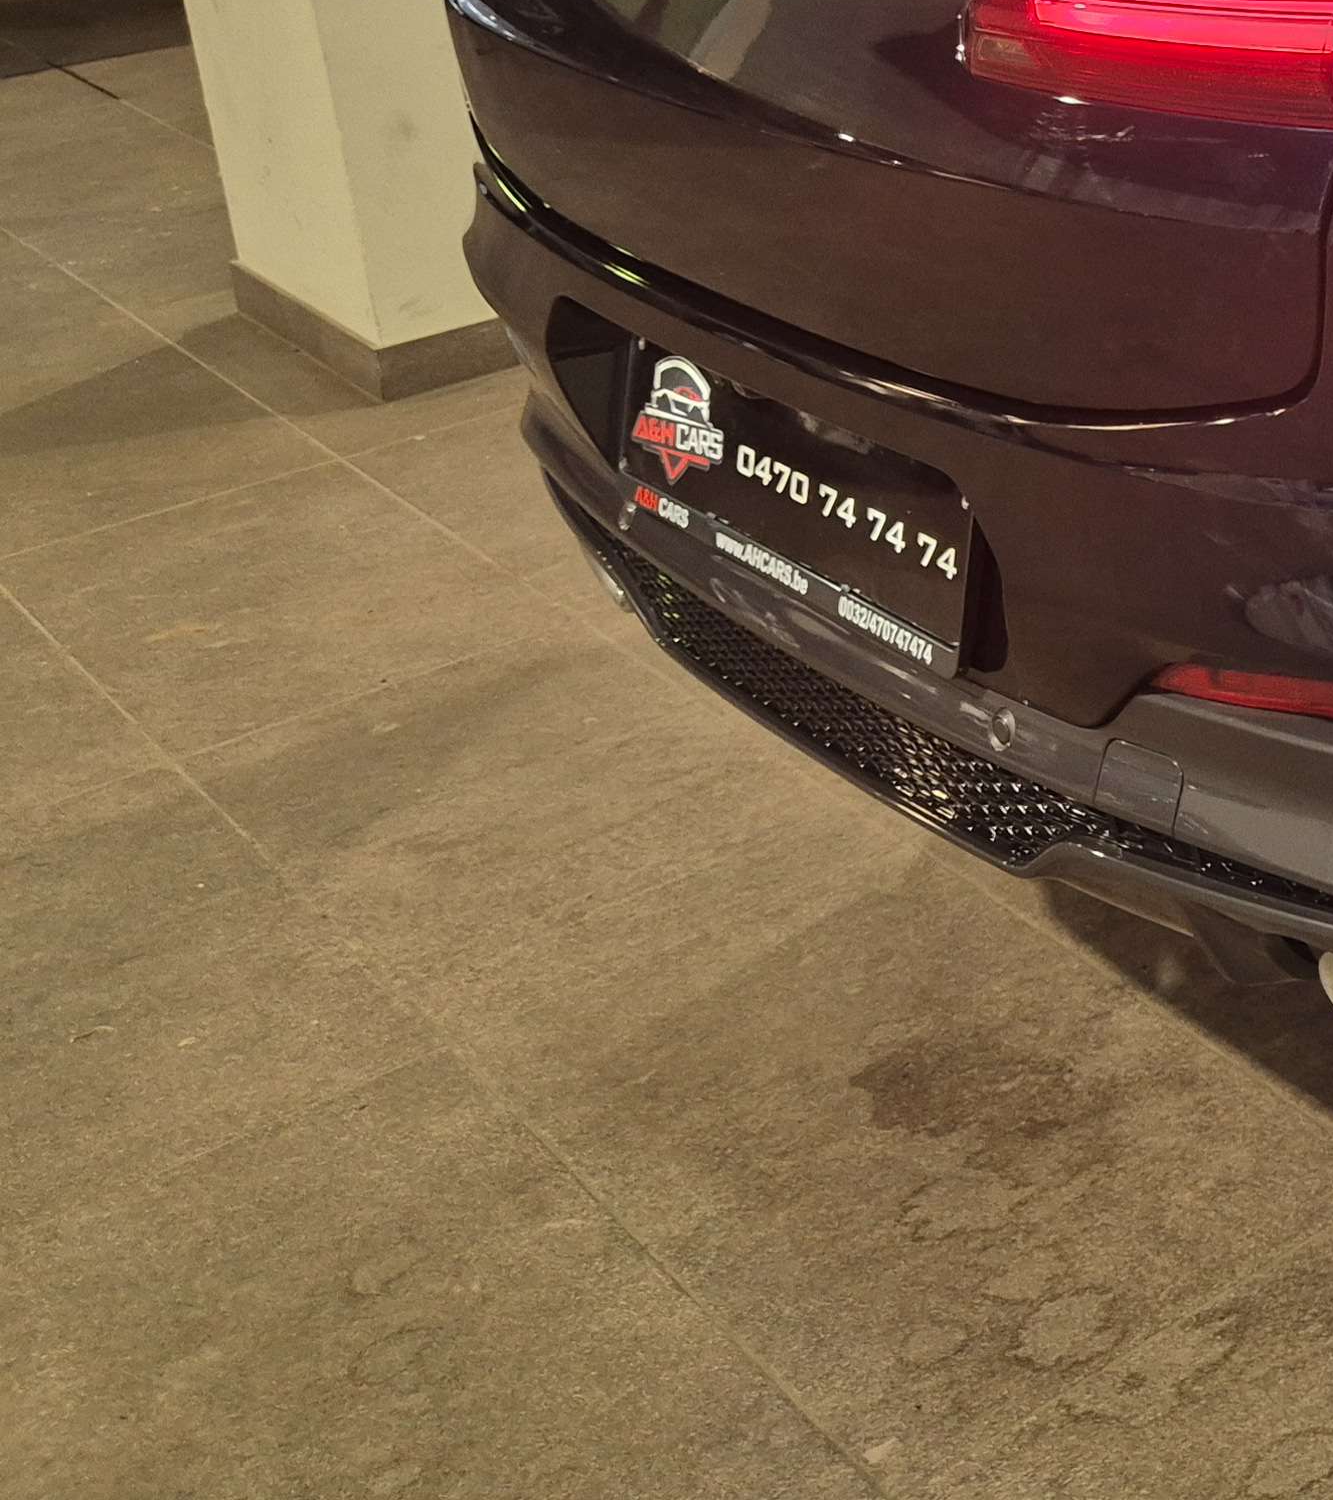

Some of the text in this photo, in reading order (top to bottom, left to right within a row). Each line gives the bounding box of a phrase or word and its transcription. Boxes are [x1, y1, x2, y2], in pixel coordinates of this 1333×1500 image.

[675, 423, 725, 461] CARS
[658, 497, 690, 529] CARS
[736, 444, 958, 580] 0470 74 74 74
[715, 532, 809, 596] www.AHCARS.be
[838, 595, 933, 666] 0032/470747474
